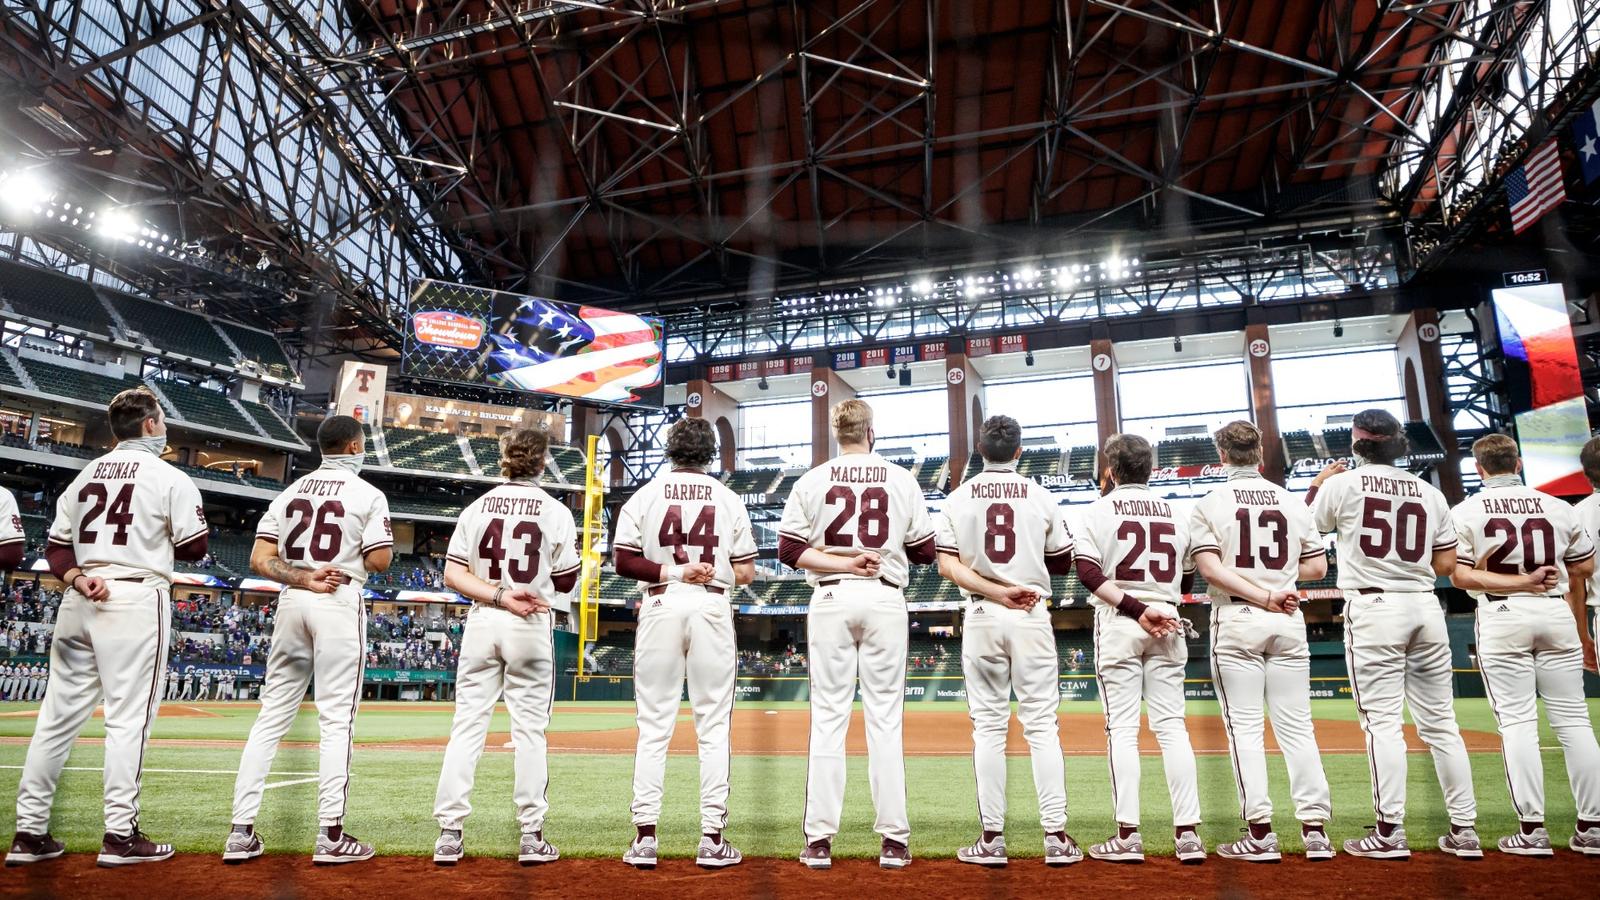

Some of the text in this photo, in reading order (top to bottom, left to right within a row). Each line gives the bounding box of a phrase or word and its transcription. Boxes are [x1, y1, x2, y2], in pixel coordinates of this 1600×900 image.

[1511, 273, 1541, 283] 10:52
[417, 324, 478, 341] Showdown
[1423, 328, 1435, 338] 10
[970, 338, 991, 348] 2015
[1001, 335, 1022, 345] 2016
[866, 349, 884, 358] 2011
[895, 346, 913, 356] 2011
[925, 343, 945, 352] 2012
[1252, 343, 1266, 353] 29
[794, 356, 812, 366] 2010
[836, 352, 855, 361] 2010
[1098, 358, 1105, 367] 7
[711, 365, 729, 374] 1996
[765, 359, 784, 369] 1999
[356, 369, 376, 392] T
[949, 371, 962, 380] 26
[814, 385, 825, 393] 34
[688, 396, 700, 405] 42
[479, 411, 523, 422] BREWING
[93, 462, 140, 480] BEDNAR
[830, 466, 887, 483] MACLEOD
[1041, 473, 1075, 487] Bank
[1361, 475, 1422, 498] PIMENTEL
[298, 479, 345, 496] LOVETT
[664, 484, 712, 500] GARNER
[740, 493, 766, 505] UNG
[1233, 489, 1279, 506] ROKOSE
[481, 496, 542, 516] FORSYTHE
[1482, 498, 1544, 514] HANCOCK
[78, 482, 135, 546] 24
[824, 485, 890, 548] 28
[285, 498, 345, 562] 26
[658, 505, 719, 566] 44
[984, 503, 1016, 564] 8
[1360, 497, 1427, 563] 50
[1235, 508, 1288, 570] 13
[478, 518, 542, 584] 43
[1115, 521, 1177, 583] 25
[1484, 518, 1555, 574] 20
[184, 665, 250, 677] Germania
[905, 686, 925, 695] arm
[1060, 681, 1088, 689] CTAW
